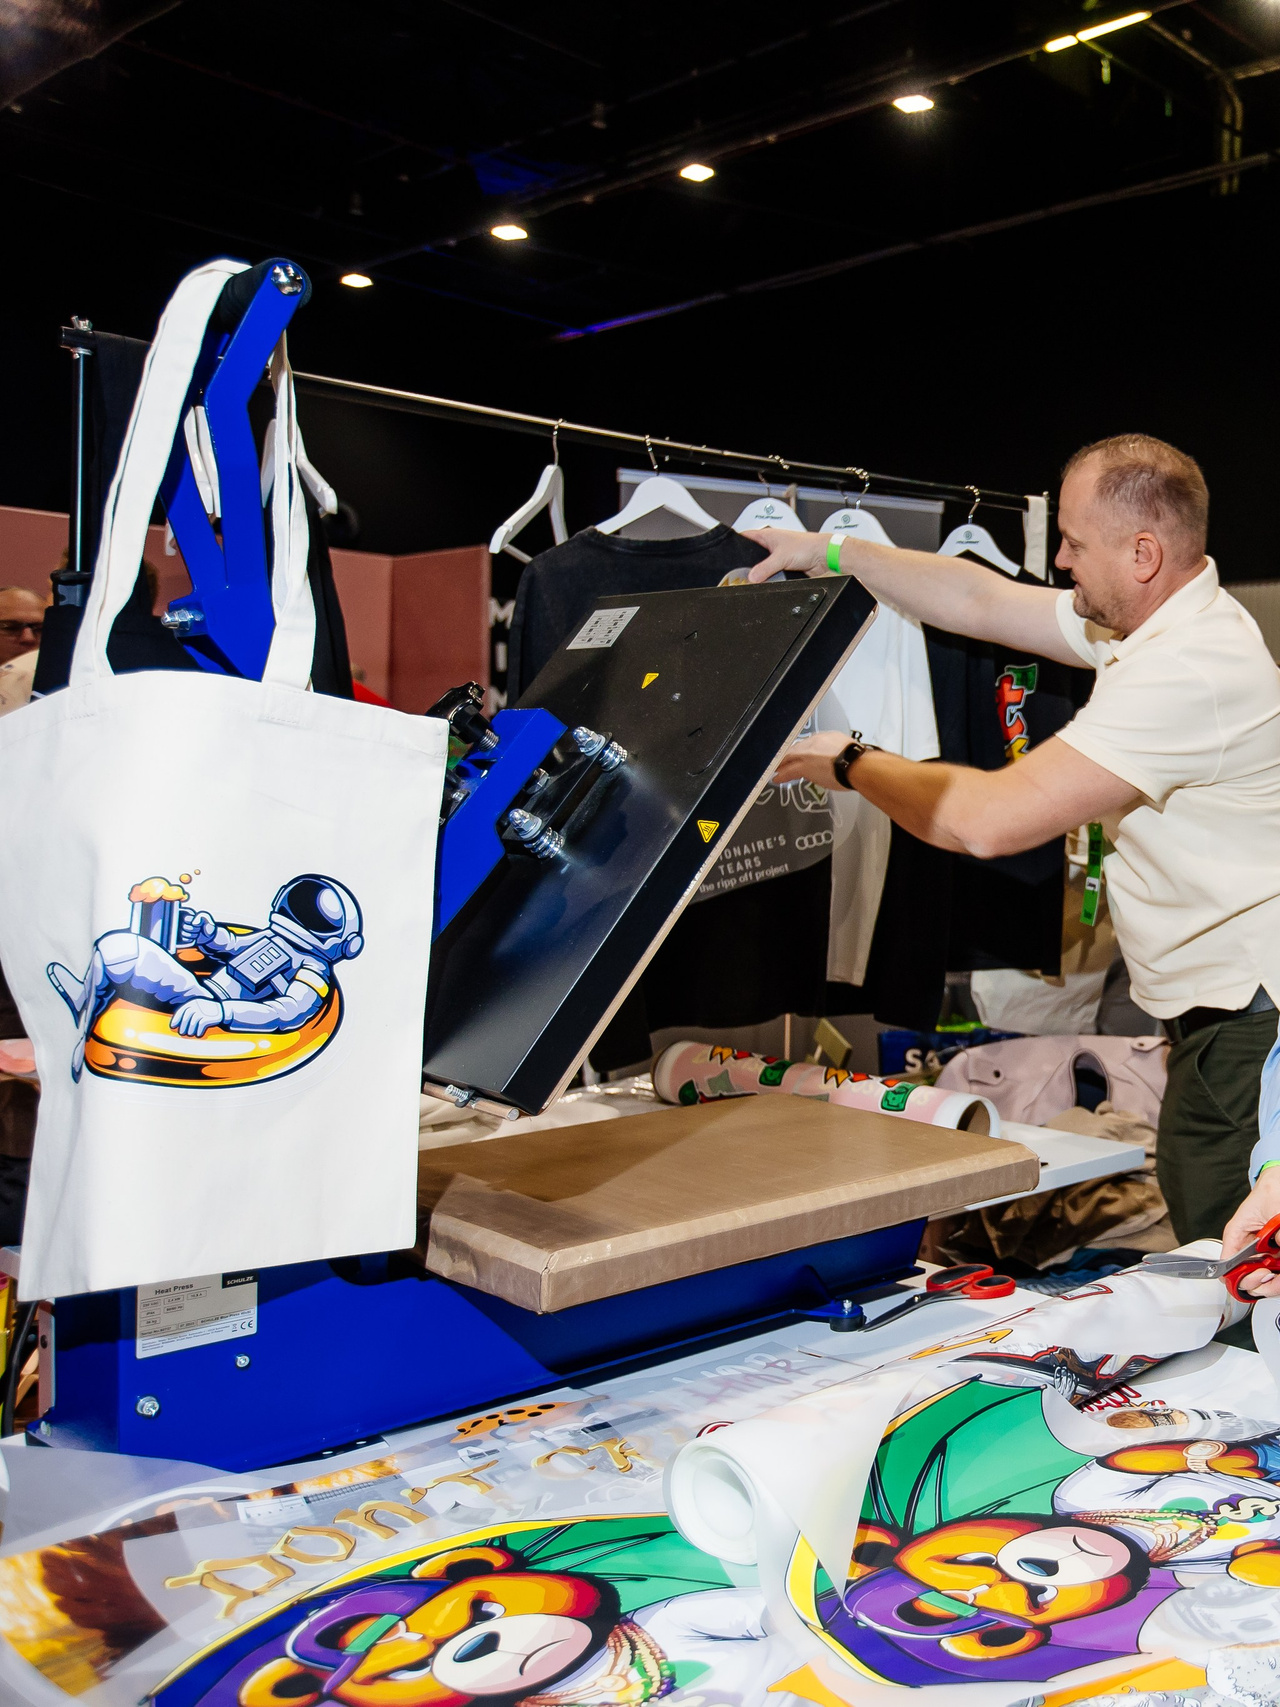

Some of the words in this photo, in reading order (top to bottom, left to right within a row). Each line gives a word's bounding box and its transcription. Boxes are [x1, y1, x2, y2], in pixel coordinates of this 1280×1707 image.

[718, 856, 762, 876] TEARS
[717, 875, 737, 890] ripp
[738, 871, 753, 884] off
[755, 863, 790, 882] project
[226, 1275, 254, 1286] SCHULZE
[155, 1285, 171, 1295] Heat
[173, 1283, 194, 1292] Press
